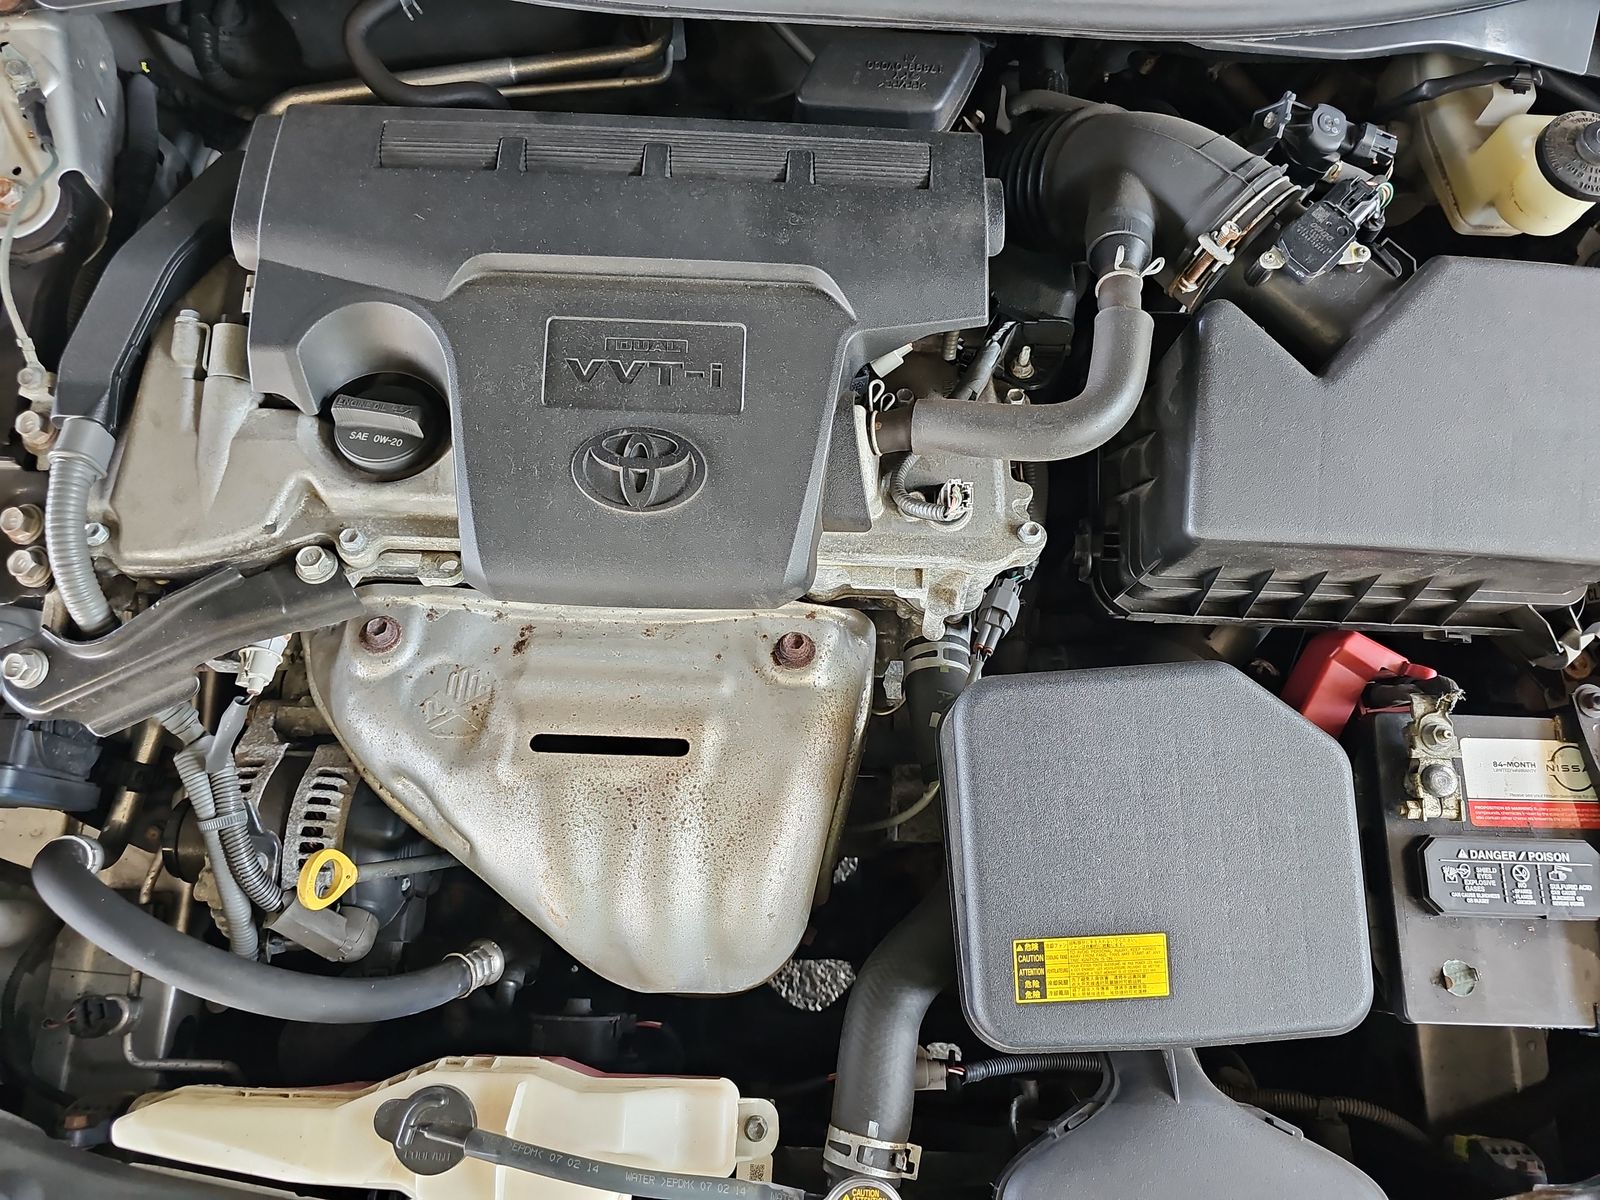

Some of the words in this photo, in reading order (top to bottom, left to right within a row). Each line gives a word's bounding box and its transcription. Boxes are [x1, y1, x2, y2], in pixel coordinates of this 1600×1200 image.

[615, 339, 681, 352] DUAL
[564, 357, 723, 388] VVT-i
[349, 431, 369, 441] SAE
[373, 434, 403, 447] 0W-20
[1492, 760, 1537, 769] 84-MONTH
[1469, 849, 1517, 861] DANGER
[1527, 851, 1570, 863] POISON
[1018, 954, 1045, 963] CAUTION
[1018, 967, 1045, 977] ATTENTION
[549, 1153, 563, 1164] 07
[567, 1158, 581, 1170] 02
[586, 1162, 600, 1173] 14
[625, 1171, 656, 1185] WATER
[700, 1181, 713, 1192] 07
[717, 1183, 730, 1194] 02
[735, 1186, 747, 1196] 14
[851, 1188, 880, 1198] CAUTION
